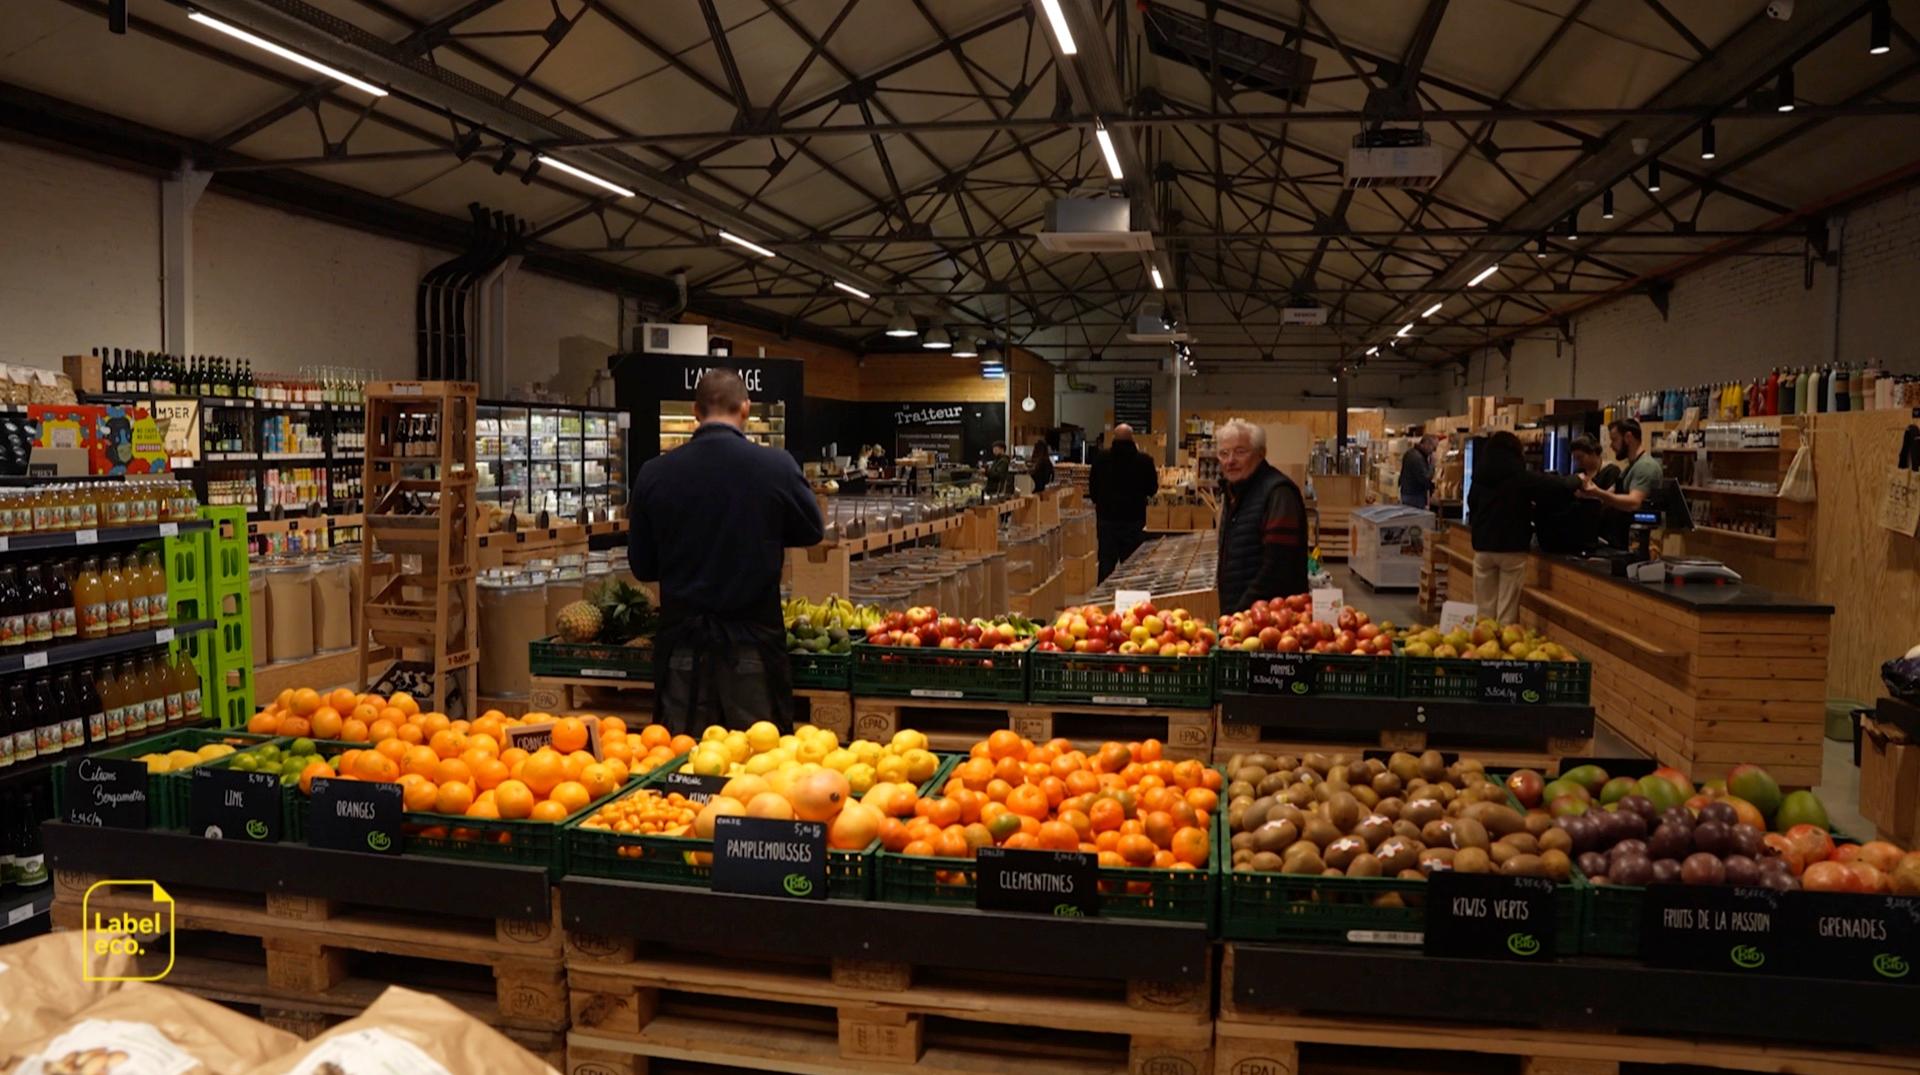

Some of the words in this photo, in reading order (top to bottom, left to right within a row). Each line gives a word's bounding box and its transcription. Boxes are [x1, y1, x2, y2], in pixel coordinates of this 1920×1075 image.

[894, 406, 963, 425] Traiteur
[1270, 664, 1296, 676] POMMES
[1501, 672, 1524, 684] POIRES
[863, 717, 884, 729] EPAL
[225, 788, 244, 808] LIME
[336, 800, 376, 820] ORANGES
[726, 839, 812, 863] PAMPLEMOUSSES
[1000, 869, 1075, 894] CLEMENTINES
[1452, 896, 1488, 918] KIWIS
[1493, 899, 1530, 921] VERTS
[1663, 907, 1694, 929] FRUITS
[1698, 908, 1711, 931] DE
[1714, 911, 1728, 931] LA
[1731, 911, 1771, 933] PASSION
[1818, 916, 1888, 941] GRENADES
